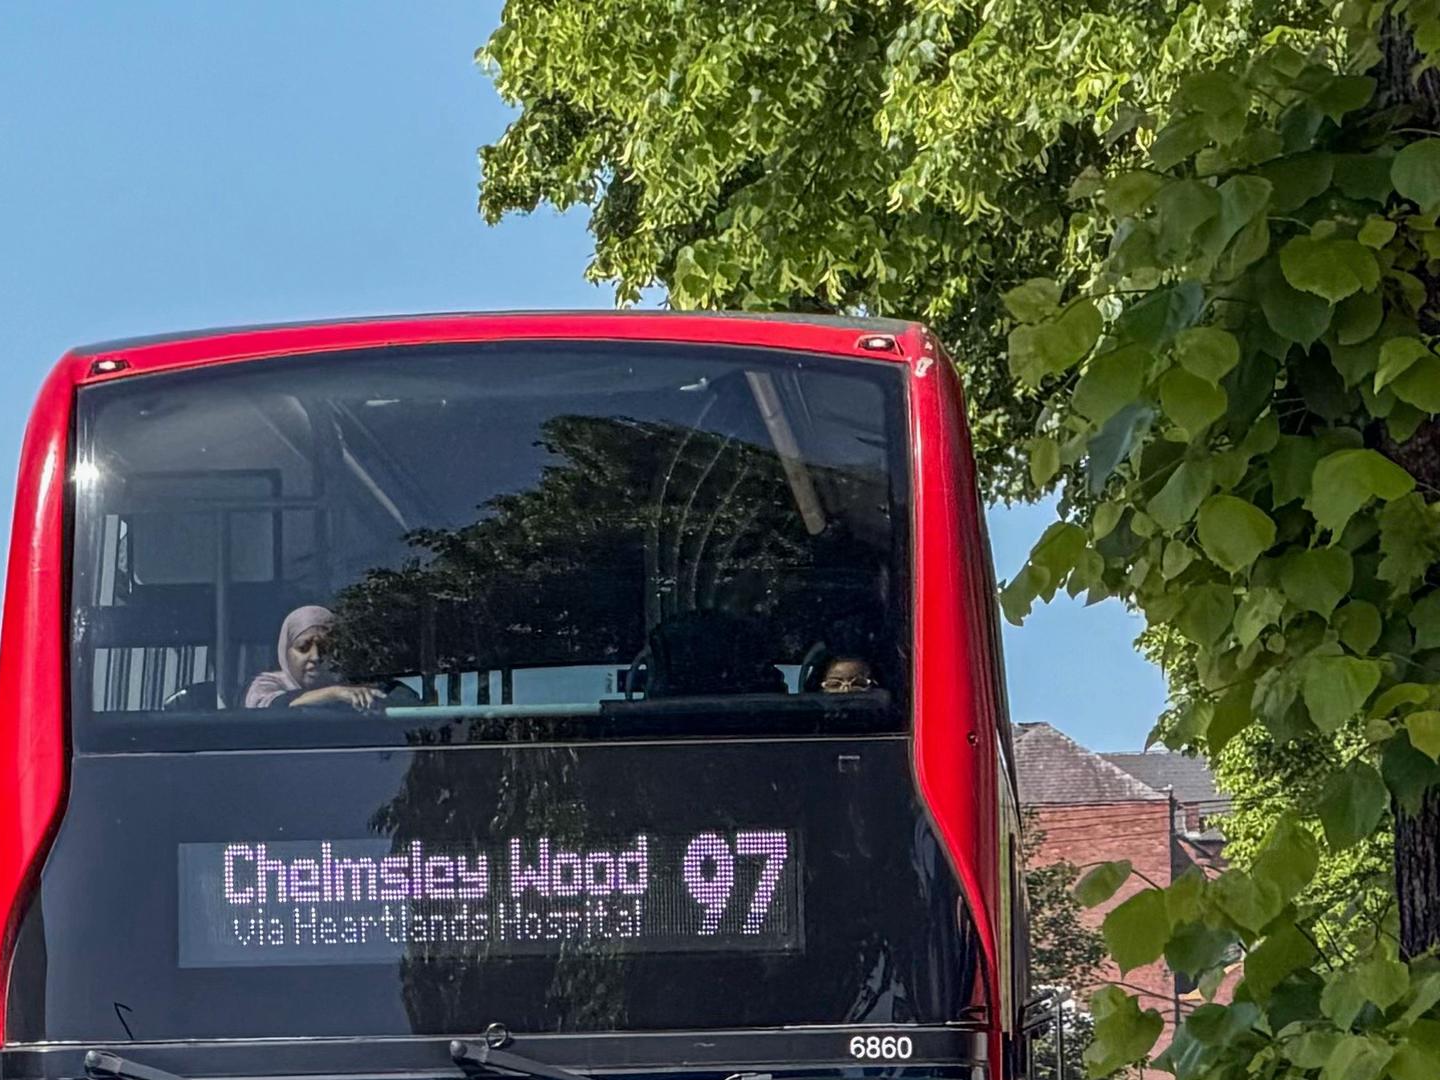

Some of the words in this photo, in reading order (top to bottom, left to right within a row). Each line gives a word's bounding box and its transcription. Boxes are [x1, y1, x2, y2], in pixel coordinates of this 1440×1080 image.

[223, 840, 489, 905] Chelmsley
[510, 835, 648, 898] Wood
[682, 831, 789, 937] 97
[233, 908, 286, 947] via
[294, 903, 489, 946] Heartlands
[499, 899, 642, 941] Hospital
[849, 1035, 913, 1059] 6860
